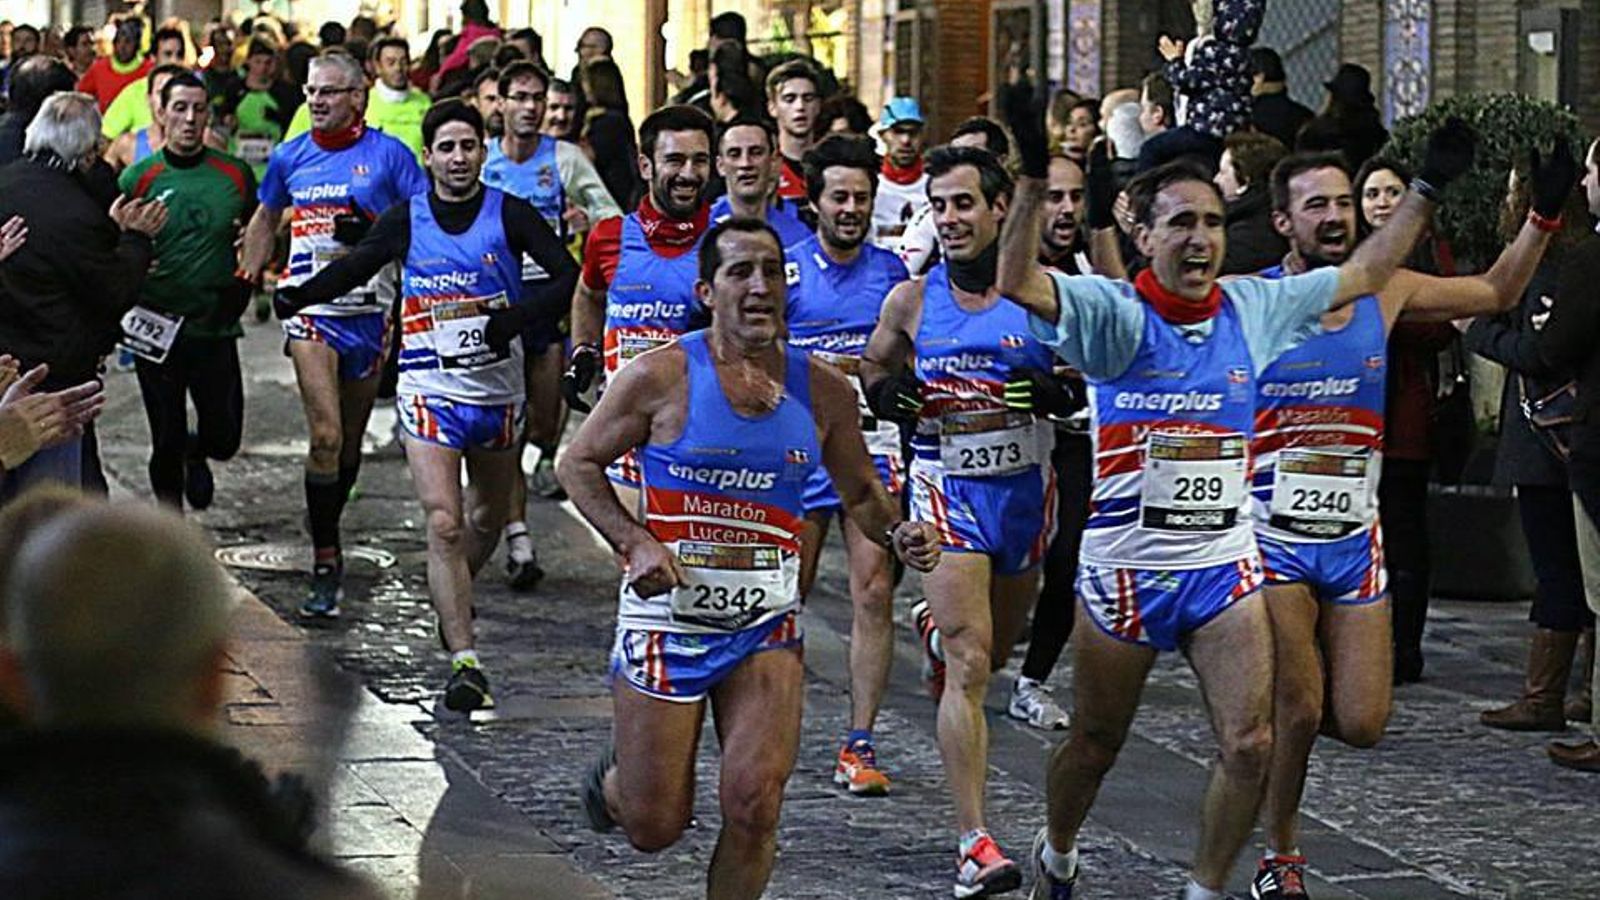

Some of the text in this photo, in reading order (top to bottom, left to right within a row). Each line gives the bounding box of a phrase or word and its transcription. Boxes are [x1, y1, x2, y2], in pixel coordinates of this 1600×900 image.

[128, 315, 165, 341] 1792
[1260, 376, 1360, 400] enerplus
[1114, 391, 1224, 414] enerplus
[960, 442, 1021, 469] 2373
[668, 462, 776, 490] enerplus
[1173, 476, 1223, 502] 289
[683, 494, 767, 522] Maratón
[1291, 489, 1352, 514] 2340
[689, 522, 760, 544] Lucena
[693, 584, 766, 612] 2342
